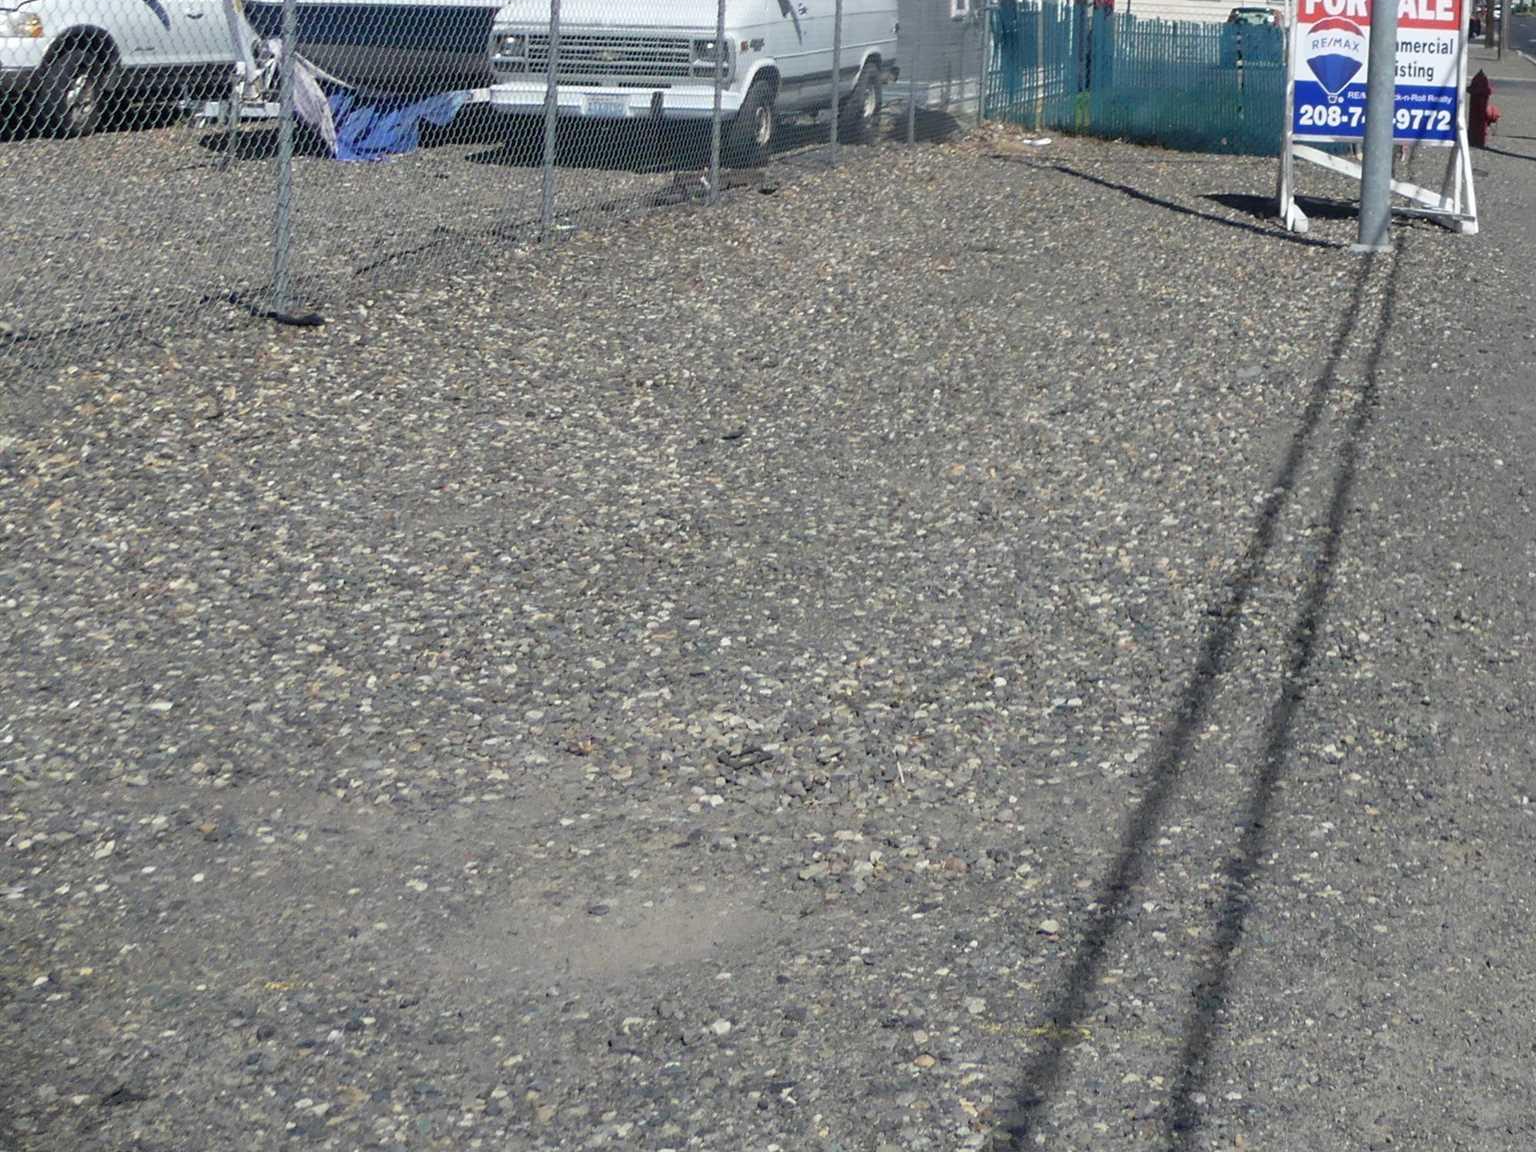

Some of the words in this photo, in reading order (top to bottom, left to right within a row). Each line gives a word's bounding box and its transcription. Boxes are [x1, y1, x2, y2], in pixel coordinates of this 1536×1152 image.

[1311, 37, 1360, 52] RE/MAX
[1395, 37, 1454, 55] mercial
[1395, 60, 1434, 82] isting
[1299, 104, 1451, 131] 208-7-9772
